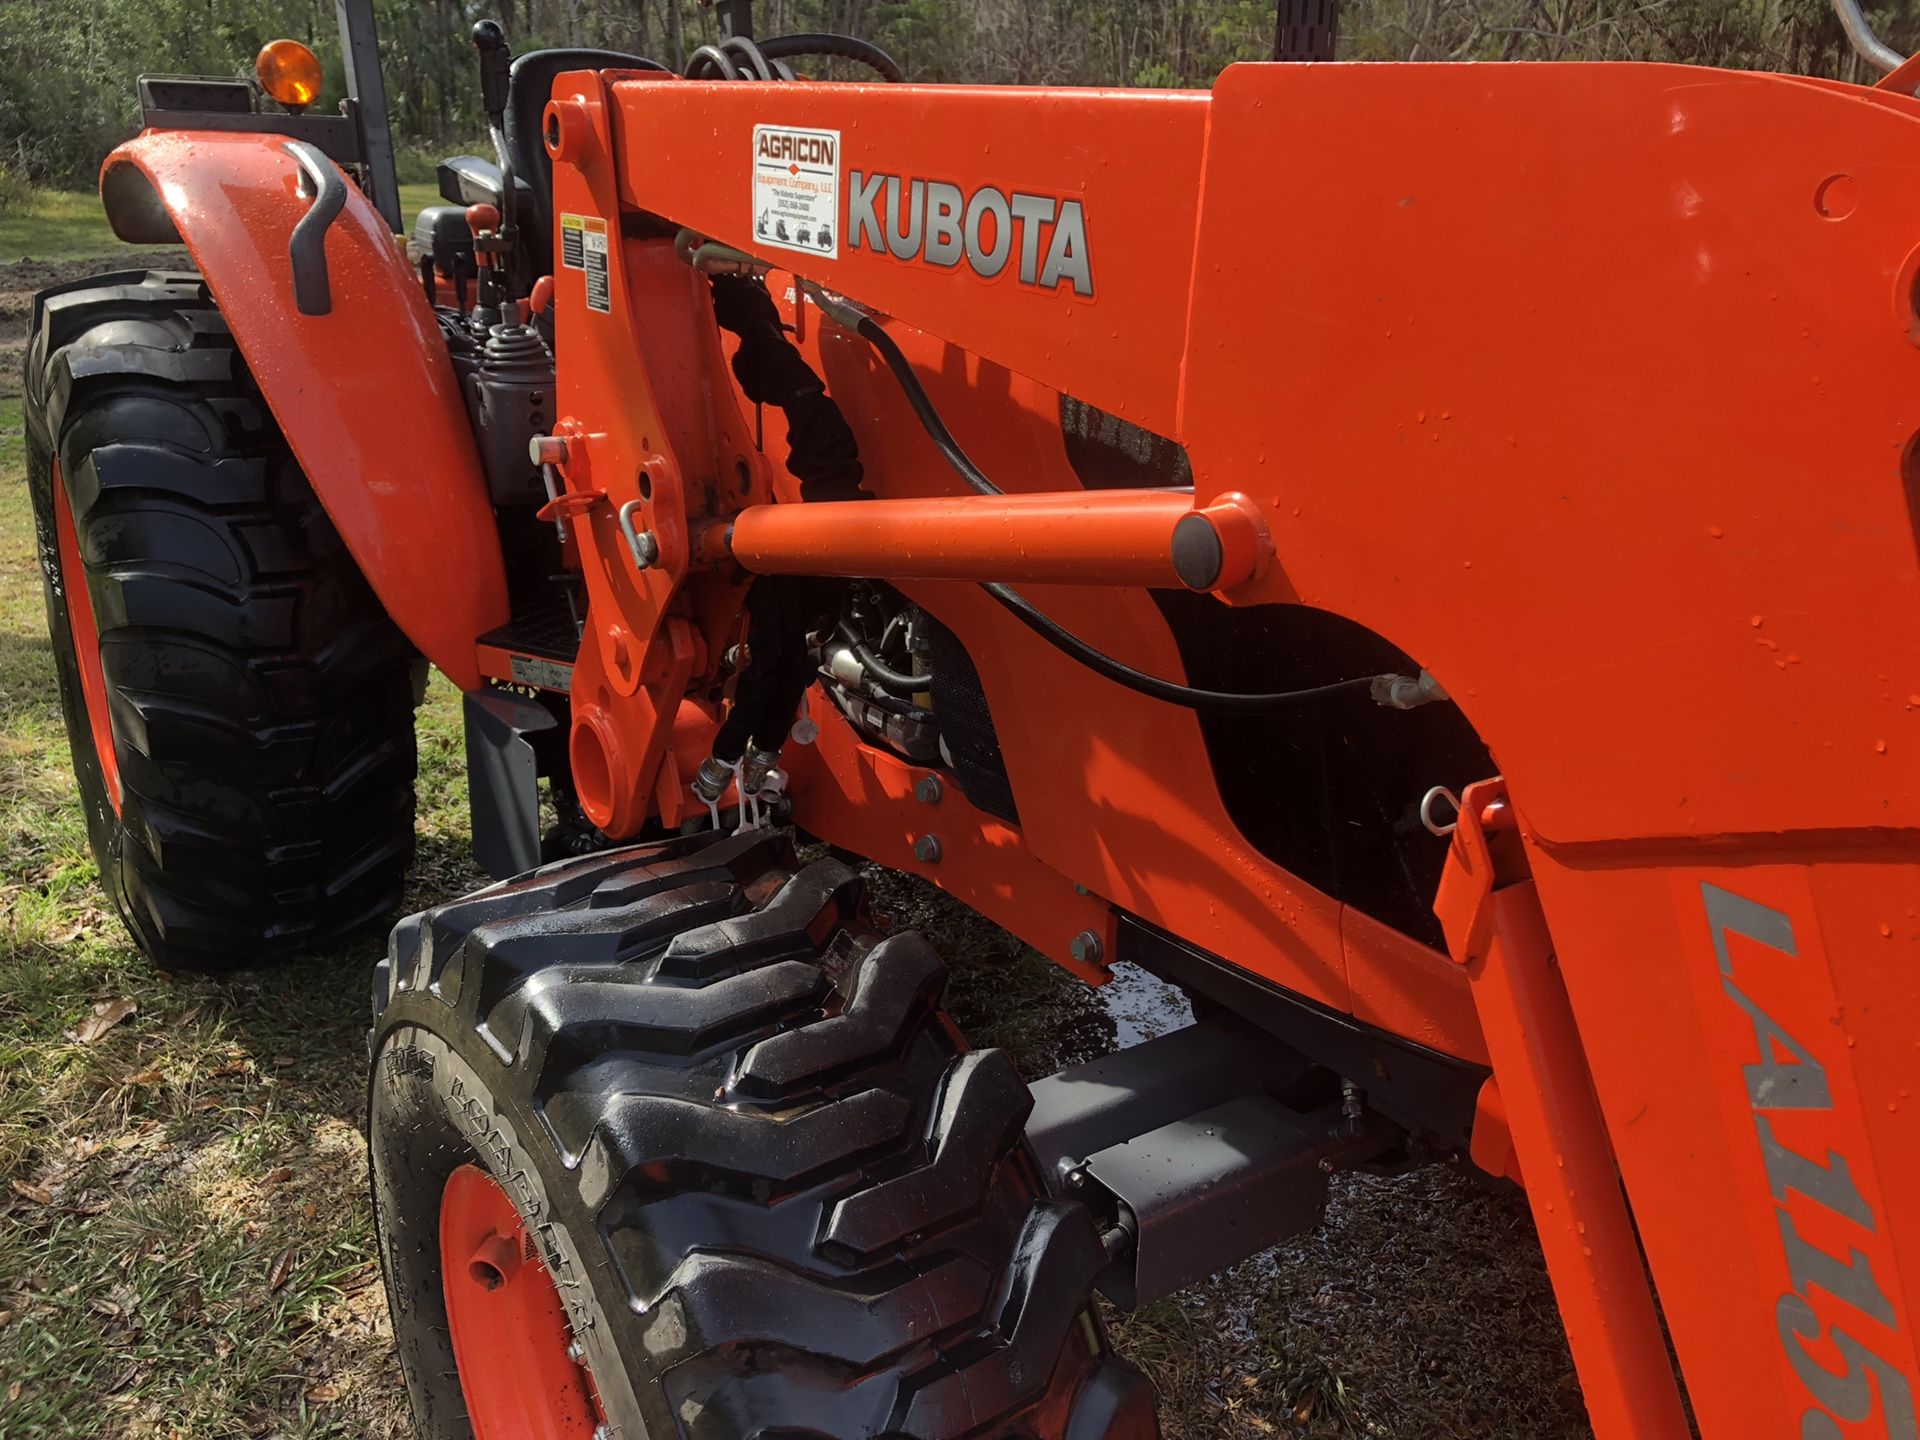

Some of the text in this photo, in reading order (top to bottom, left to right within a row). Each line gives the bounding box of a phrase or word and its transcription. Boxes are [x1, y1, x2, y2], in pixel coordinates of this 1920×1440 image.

[757, 173, 788, 188] Equipment
[821, 182, 833, 194] LLC
[758, 133, 834, 166] AGRICON
[847, 169, 1094, 297] KUBOTA
[1700, 880, 1920, 1440] LA115
